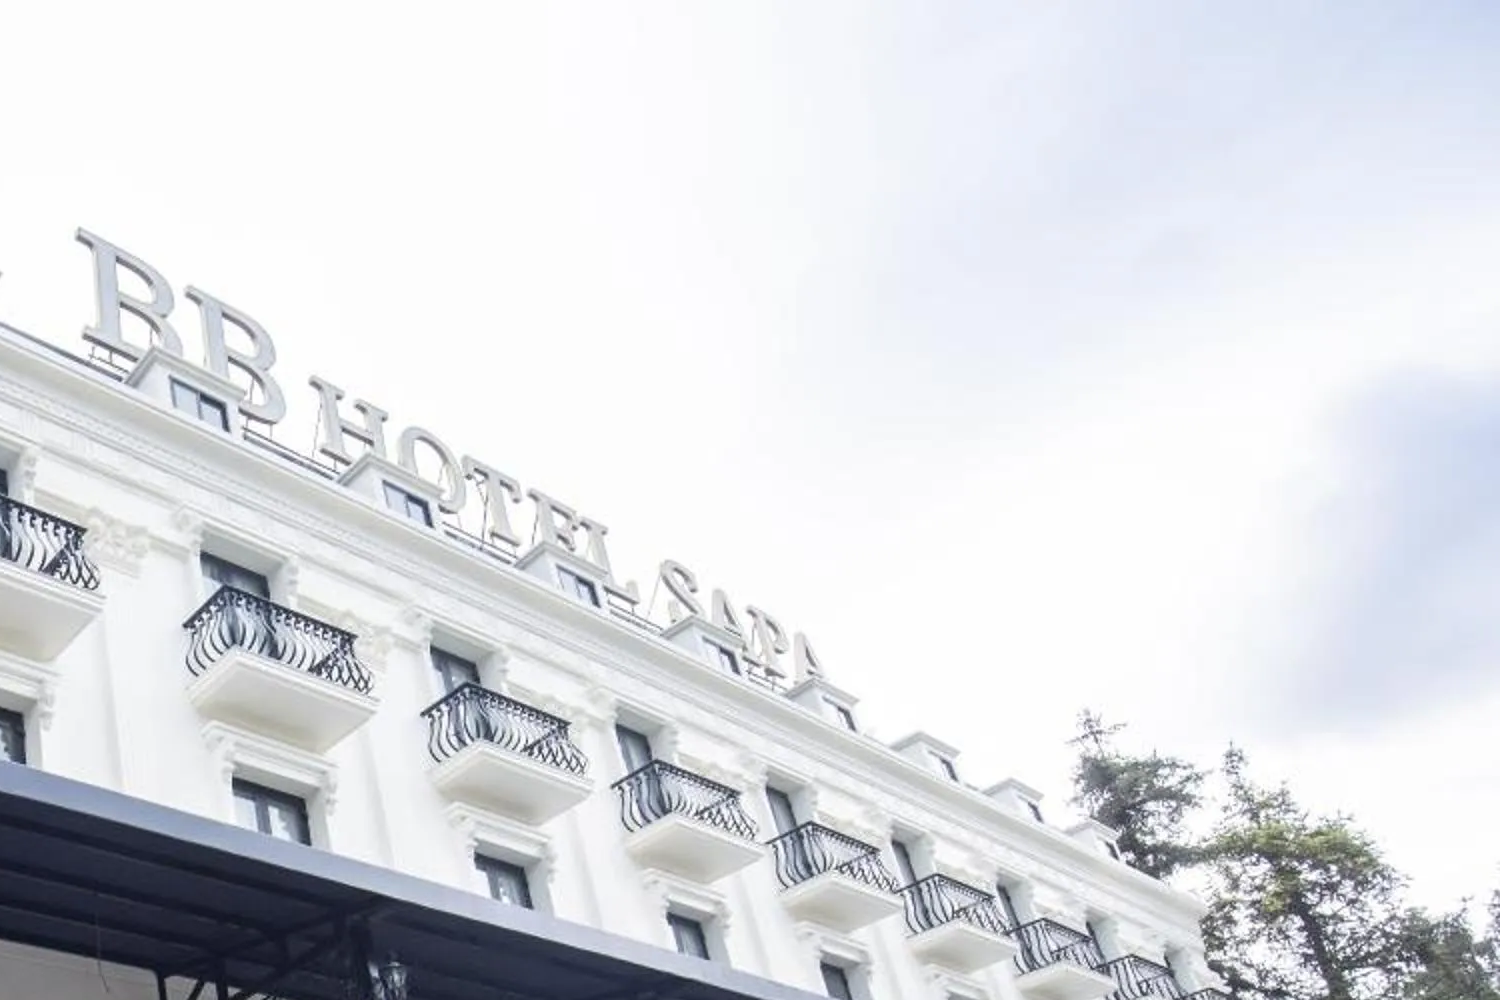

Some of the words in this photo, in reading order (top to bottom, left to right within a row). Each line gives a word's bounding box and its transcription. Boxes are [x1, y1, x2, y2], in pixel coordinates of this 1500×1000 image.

[75, 226, 287, 425] BB
[308, 375, 640, 605] HOTEL
[660, 559, 825, 686] SAPA
